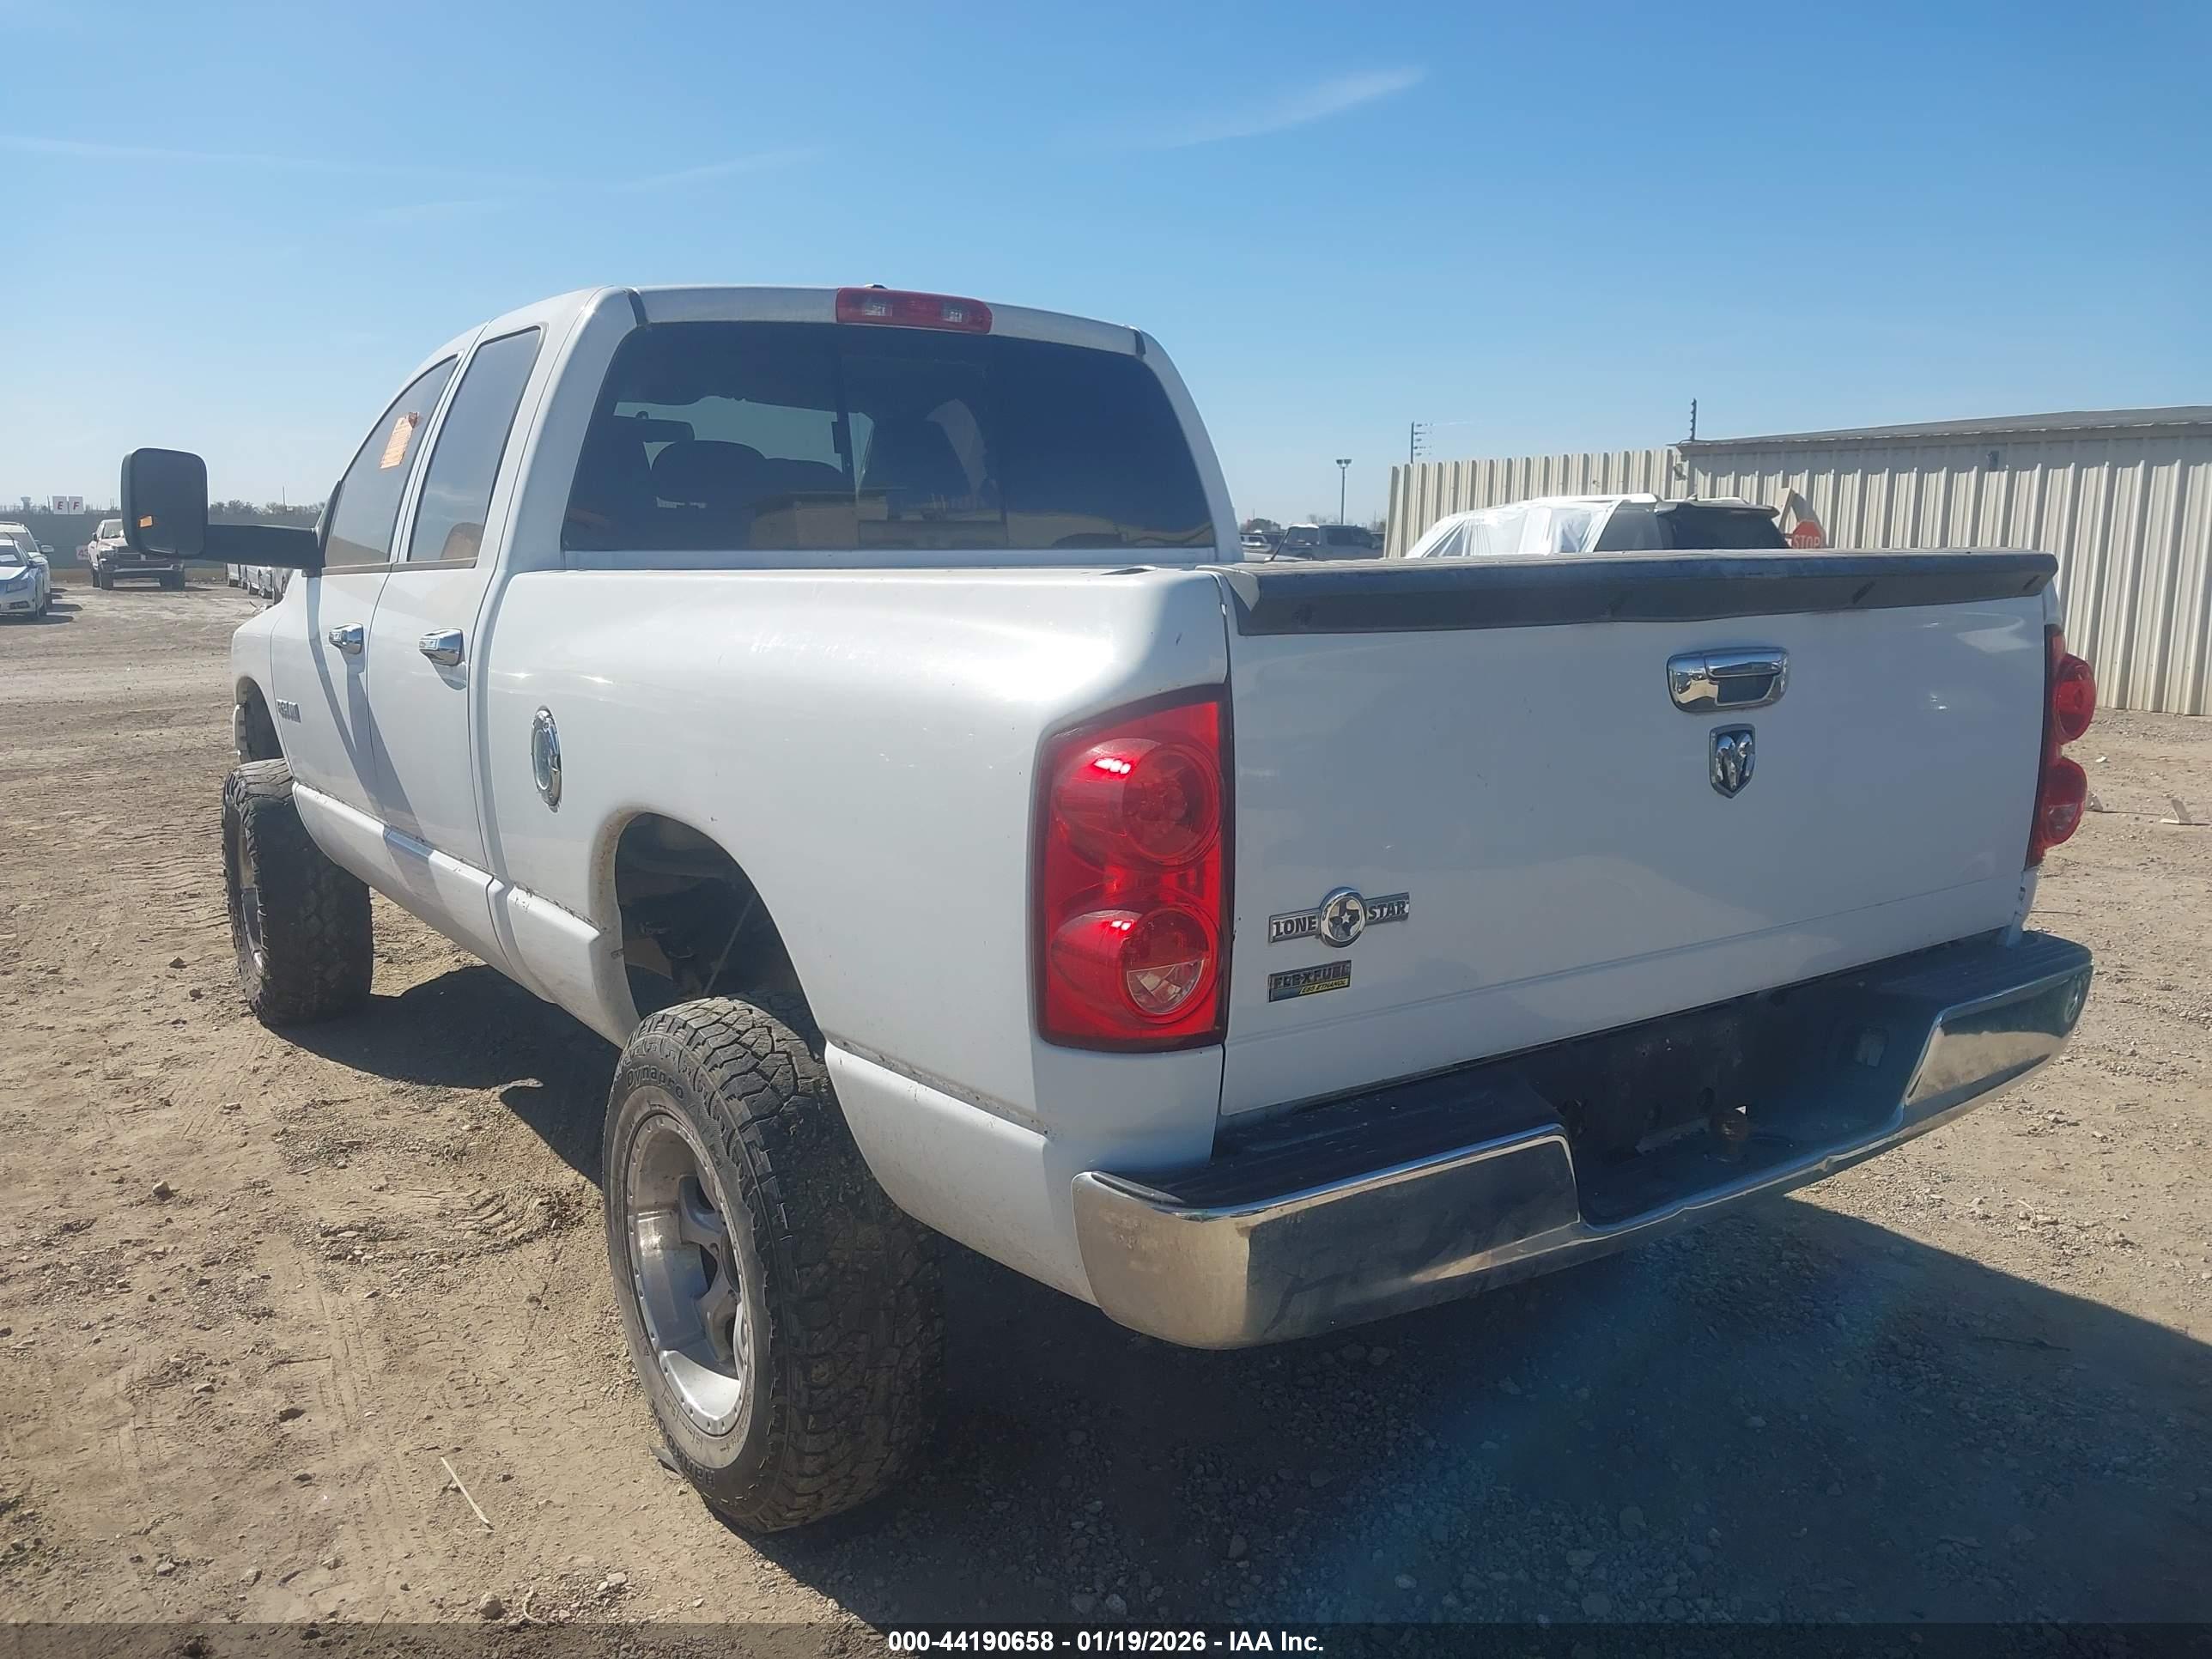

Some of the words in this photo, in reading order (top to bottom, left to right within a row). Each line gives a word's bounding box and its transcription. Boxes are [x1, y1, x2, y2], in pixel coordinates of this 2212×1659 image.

[1793, 535, 1820, 549] STOP
[1272, 915, 1317, 937] LONE
[1367, 900, 1407, 920] STAR
